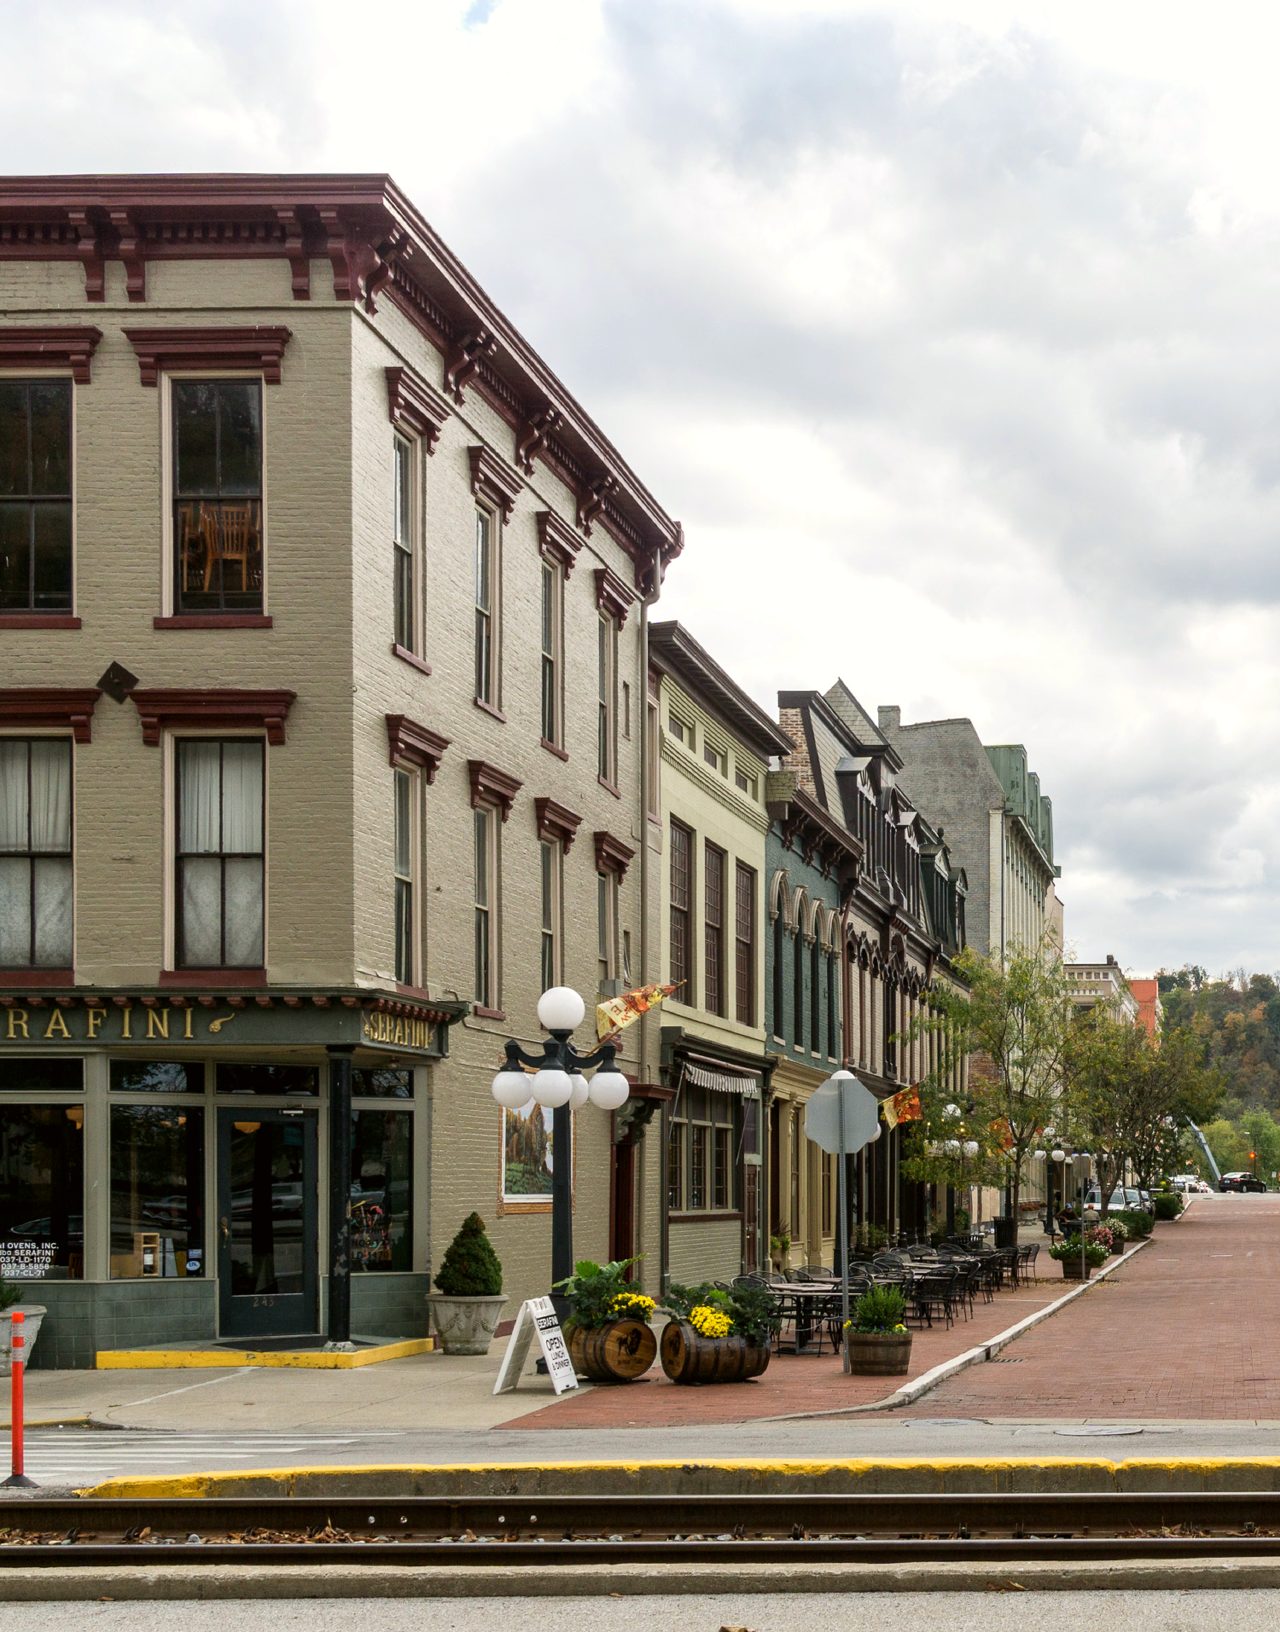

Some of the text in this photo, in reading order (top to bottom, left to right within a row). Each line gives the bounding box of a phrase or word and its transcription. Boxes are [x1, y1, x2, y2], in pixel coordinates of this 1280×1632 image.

[370, 1012, 429, 1049] SERAFINI
[7, 1242, 40, 1250] OVENS,
[41, 1242, 60, 1250] INC.
[545, 1337, 563, 1351] OPEN
